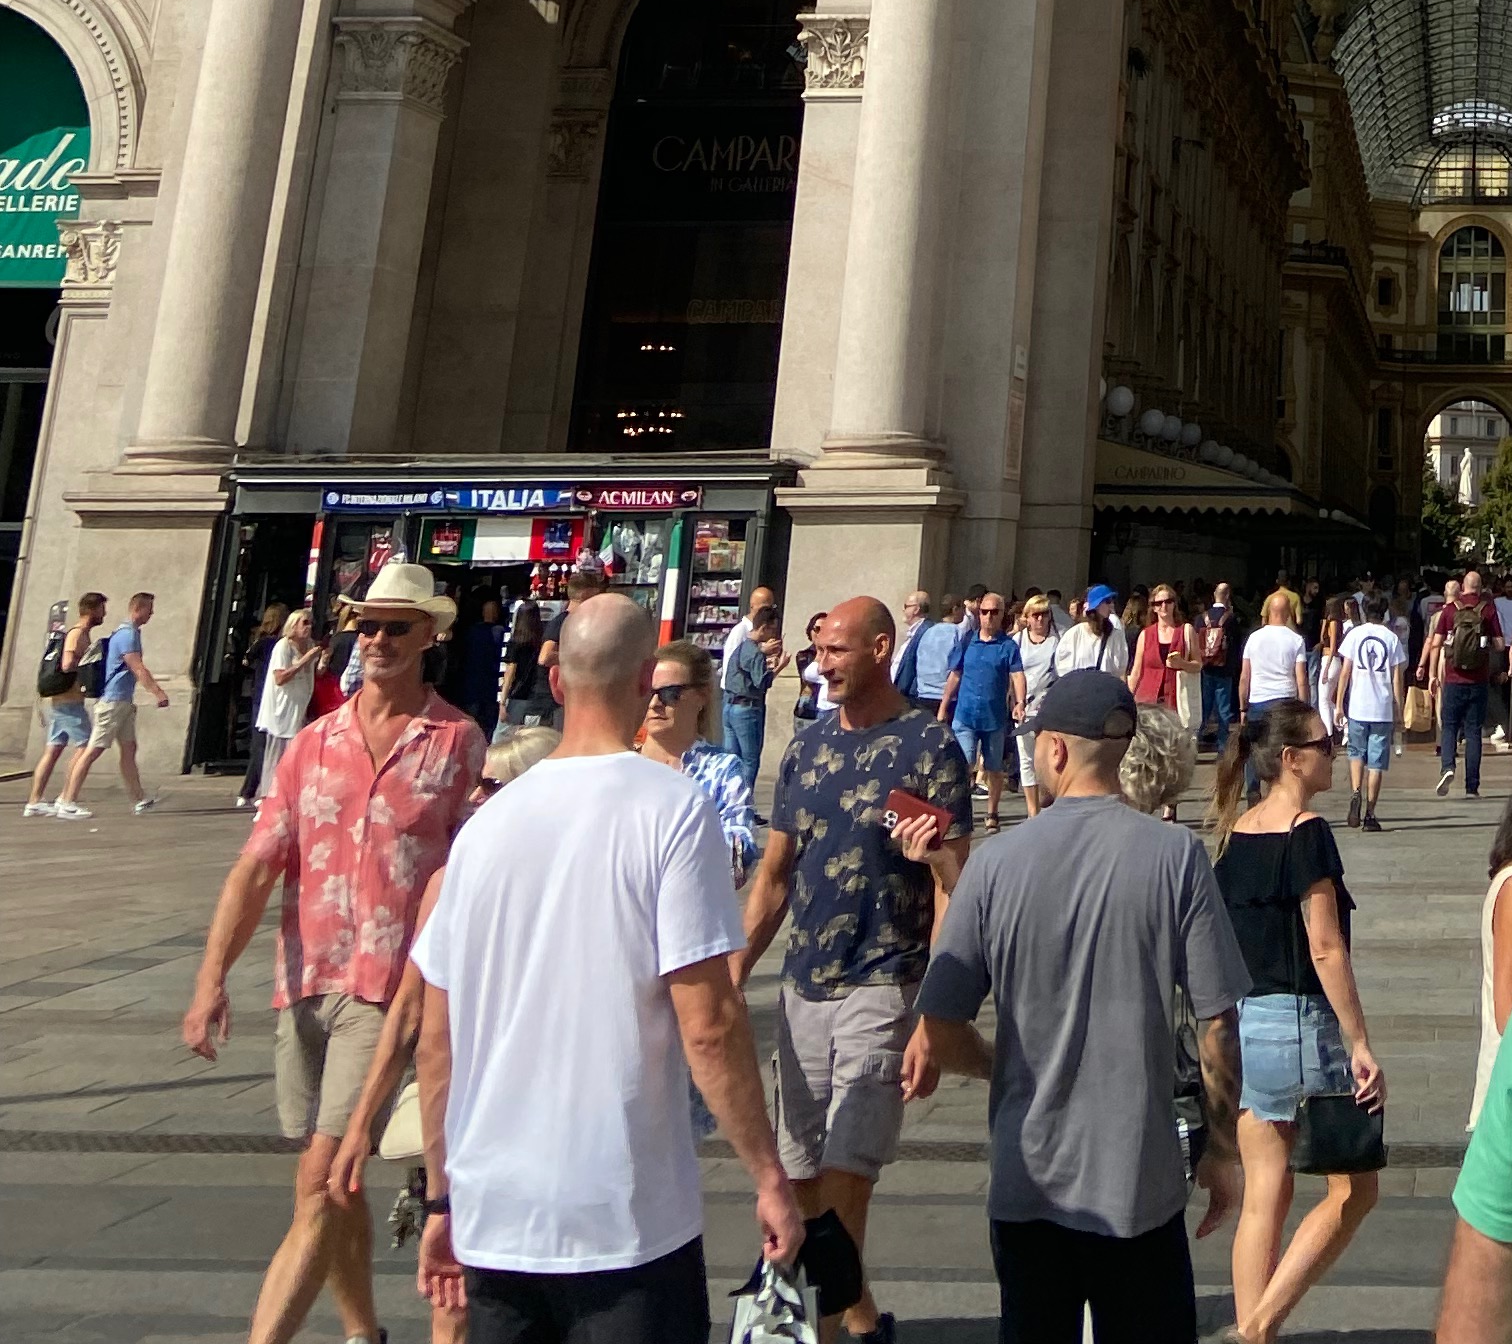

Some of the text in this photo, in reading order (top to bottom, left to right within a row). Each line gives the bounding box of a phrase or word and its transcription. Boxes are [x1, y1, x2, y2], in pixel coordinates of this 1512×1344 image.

[653, 134, 798, 172] CAMPAR
[0, 244, 69, 259] ANRE
[471, 488, 545, 510] ITALIA
